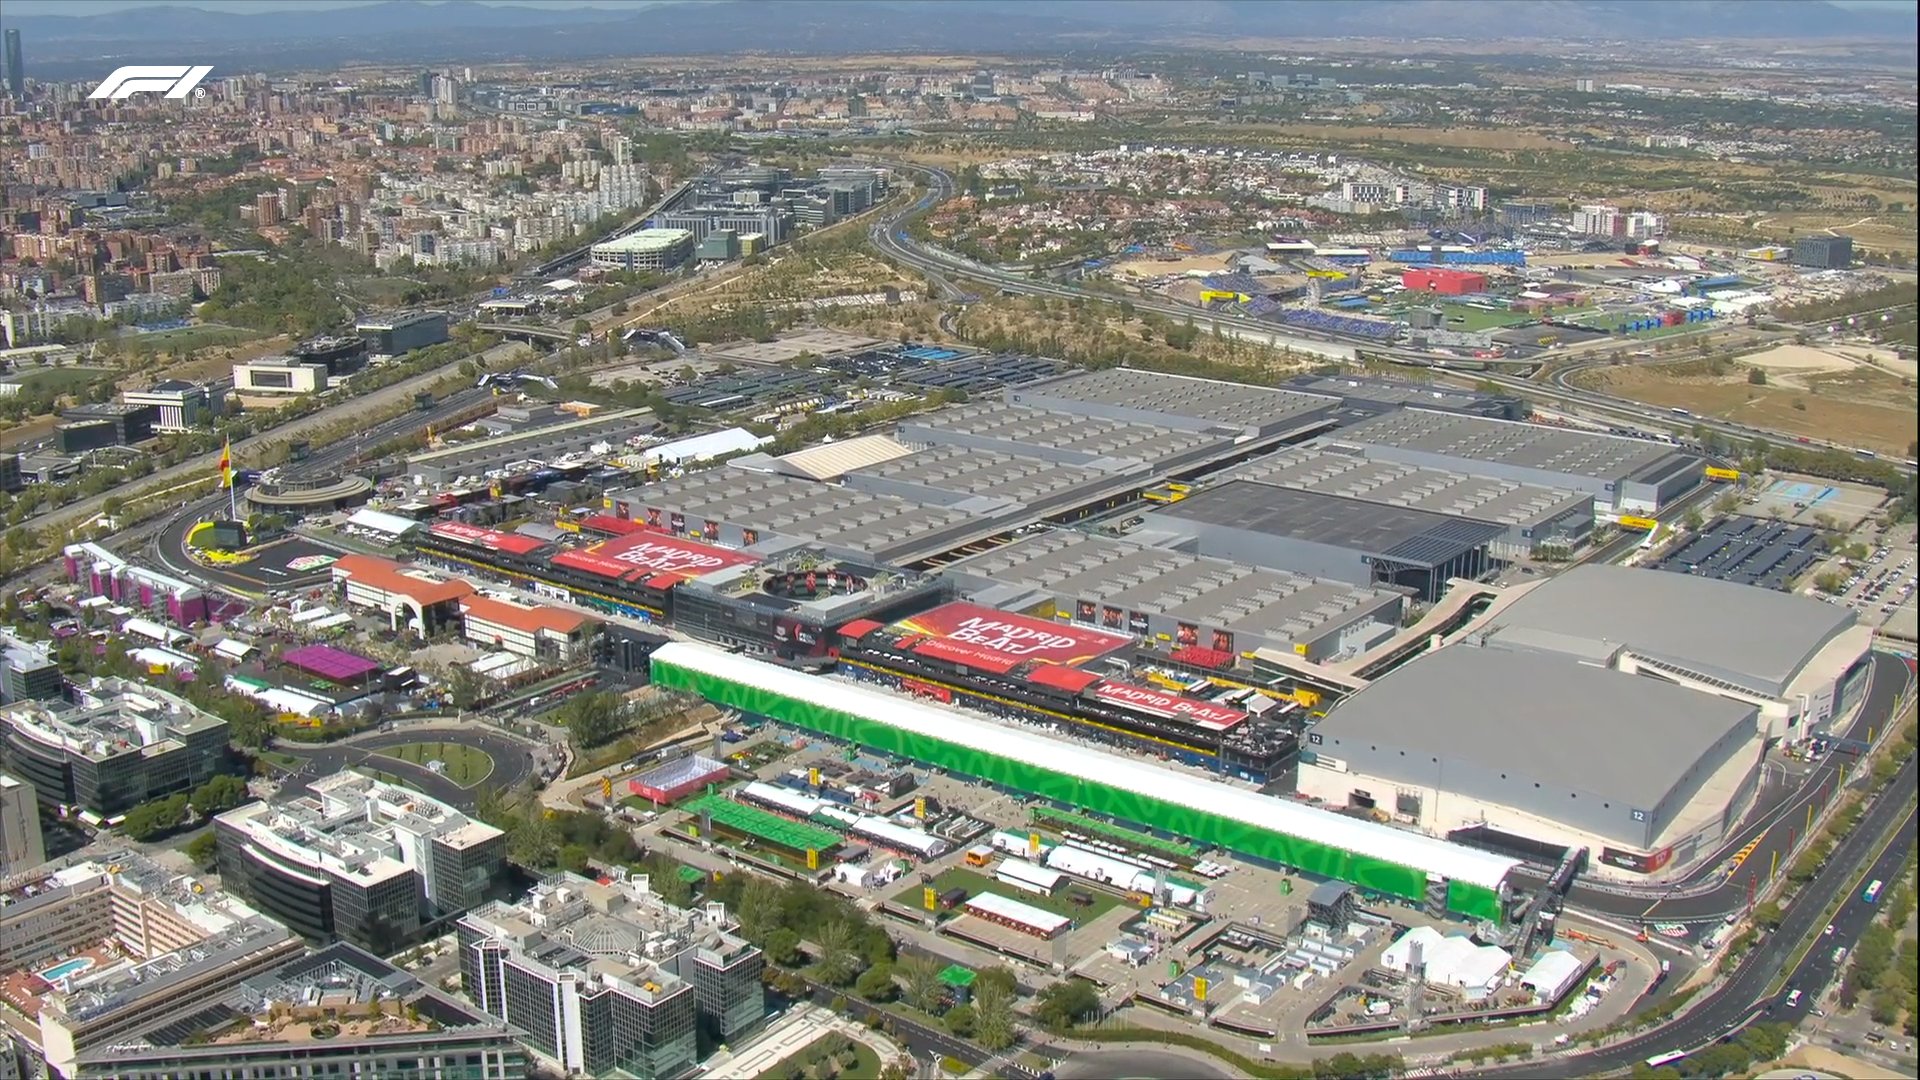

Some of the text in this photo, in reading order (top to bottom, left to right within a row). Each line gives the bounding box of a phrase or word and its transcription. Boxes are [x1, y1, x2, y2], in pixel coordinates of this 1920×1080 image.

[629, 542, 723, 567] MADRID
[957, 617, 1076, 648] MADRID
[926, 639, 1016, 666] Discover Madrid
[1098, 684, 1170, 706] MADRID
[1312, 735, 1320, 743] 12
[1633, 811, 1644, 821] 12
